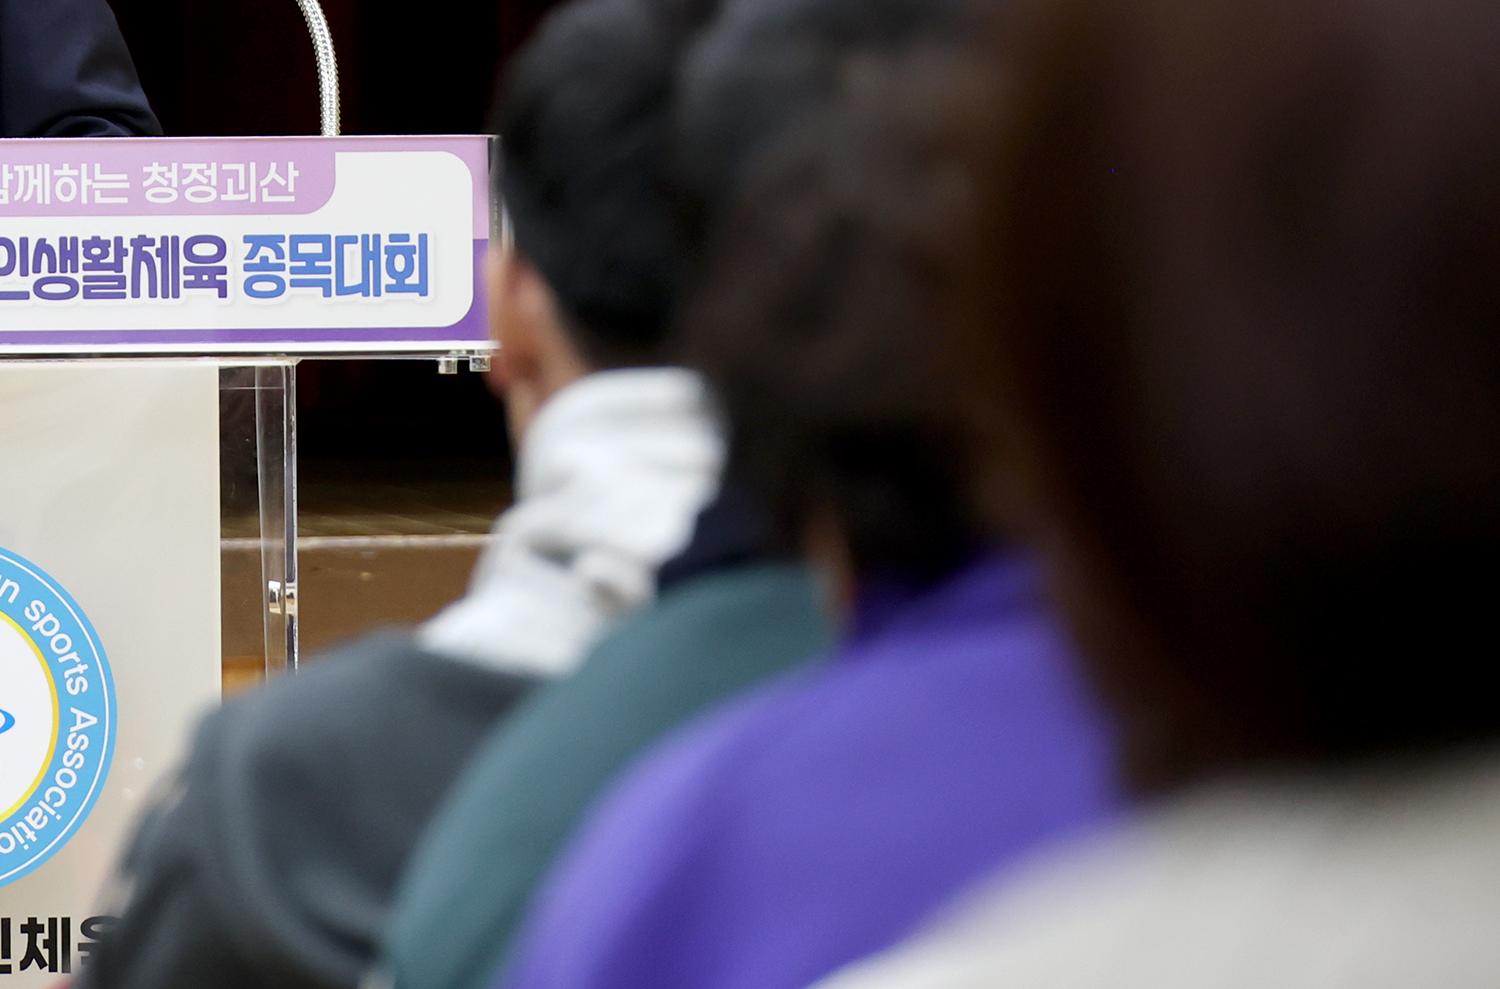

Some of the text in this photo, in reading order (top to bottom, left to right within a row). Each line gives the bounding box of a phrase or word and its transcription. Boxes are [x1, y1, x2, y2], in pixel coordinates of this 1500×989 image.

[141, 161, 300, 204] 청정괴산
[242, 232, 429, 299] 종목대회
[24, 599, 88, 696] sports
